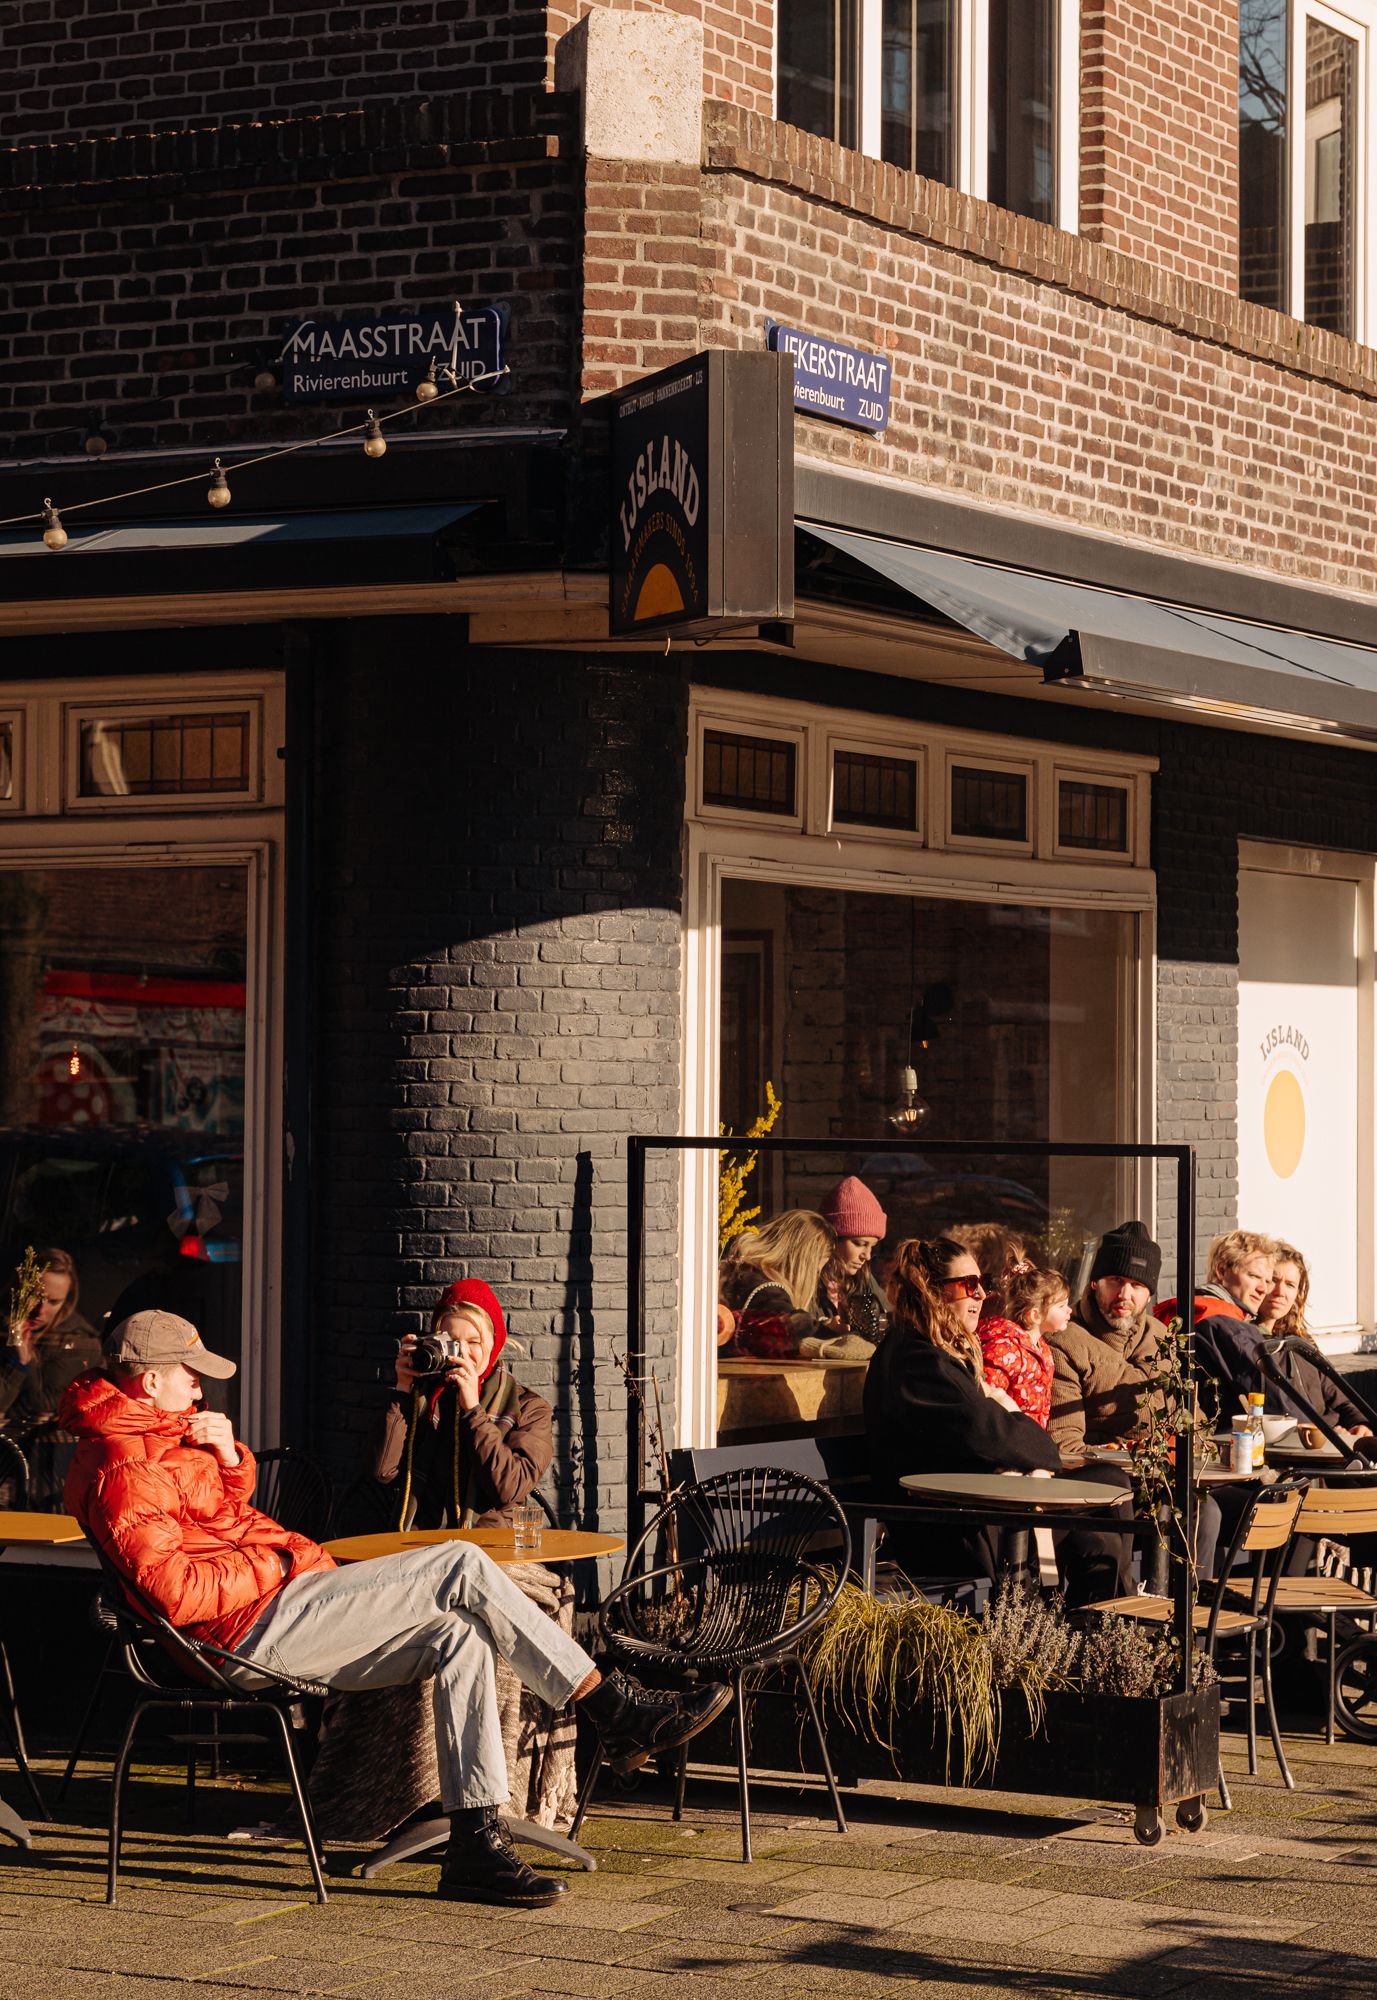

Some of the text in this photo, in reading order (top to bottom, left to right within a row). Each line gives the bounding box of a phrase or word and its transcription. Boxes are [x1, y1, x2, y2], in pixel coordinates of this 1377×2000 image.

[293, 317, 486, 364] MAASSTRAAT
[293, 360, 486, 393] Rivierenbuurt ZUID
[858, 398, 884, 421] ZUID
[619, 435, 700, 552] IJSLAND
[1259, 1025, 1310, 1061] IJSLAND
